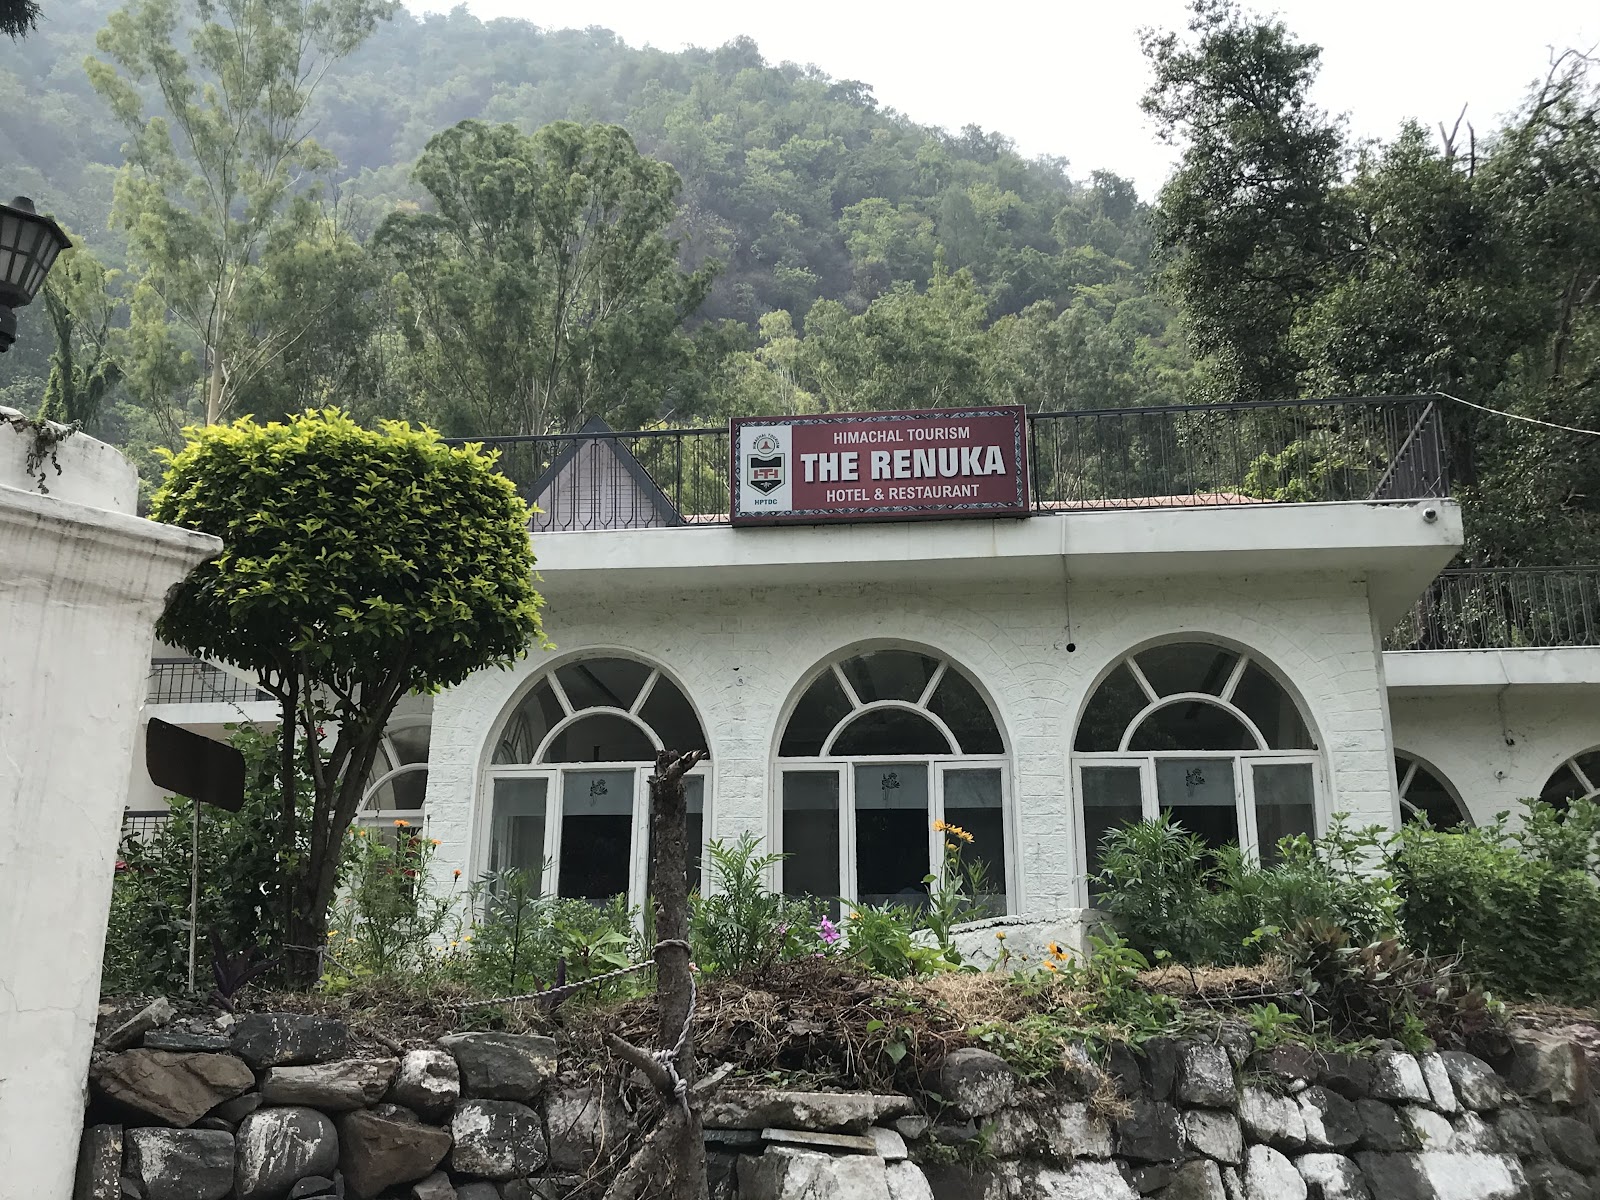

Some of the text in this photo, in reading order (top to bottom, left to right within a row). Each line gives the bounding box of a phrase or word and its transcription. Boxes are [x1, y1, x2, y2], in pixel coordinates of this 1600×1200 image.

[833, 426, 970, 445] HIMACHAL TOURISM
[800, 445, 1006, 482] THE RENUKA
[754, 498, 778, 506] HPTDC
[826, 484, 980, 502] HOTEL & RESTAURANT
